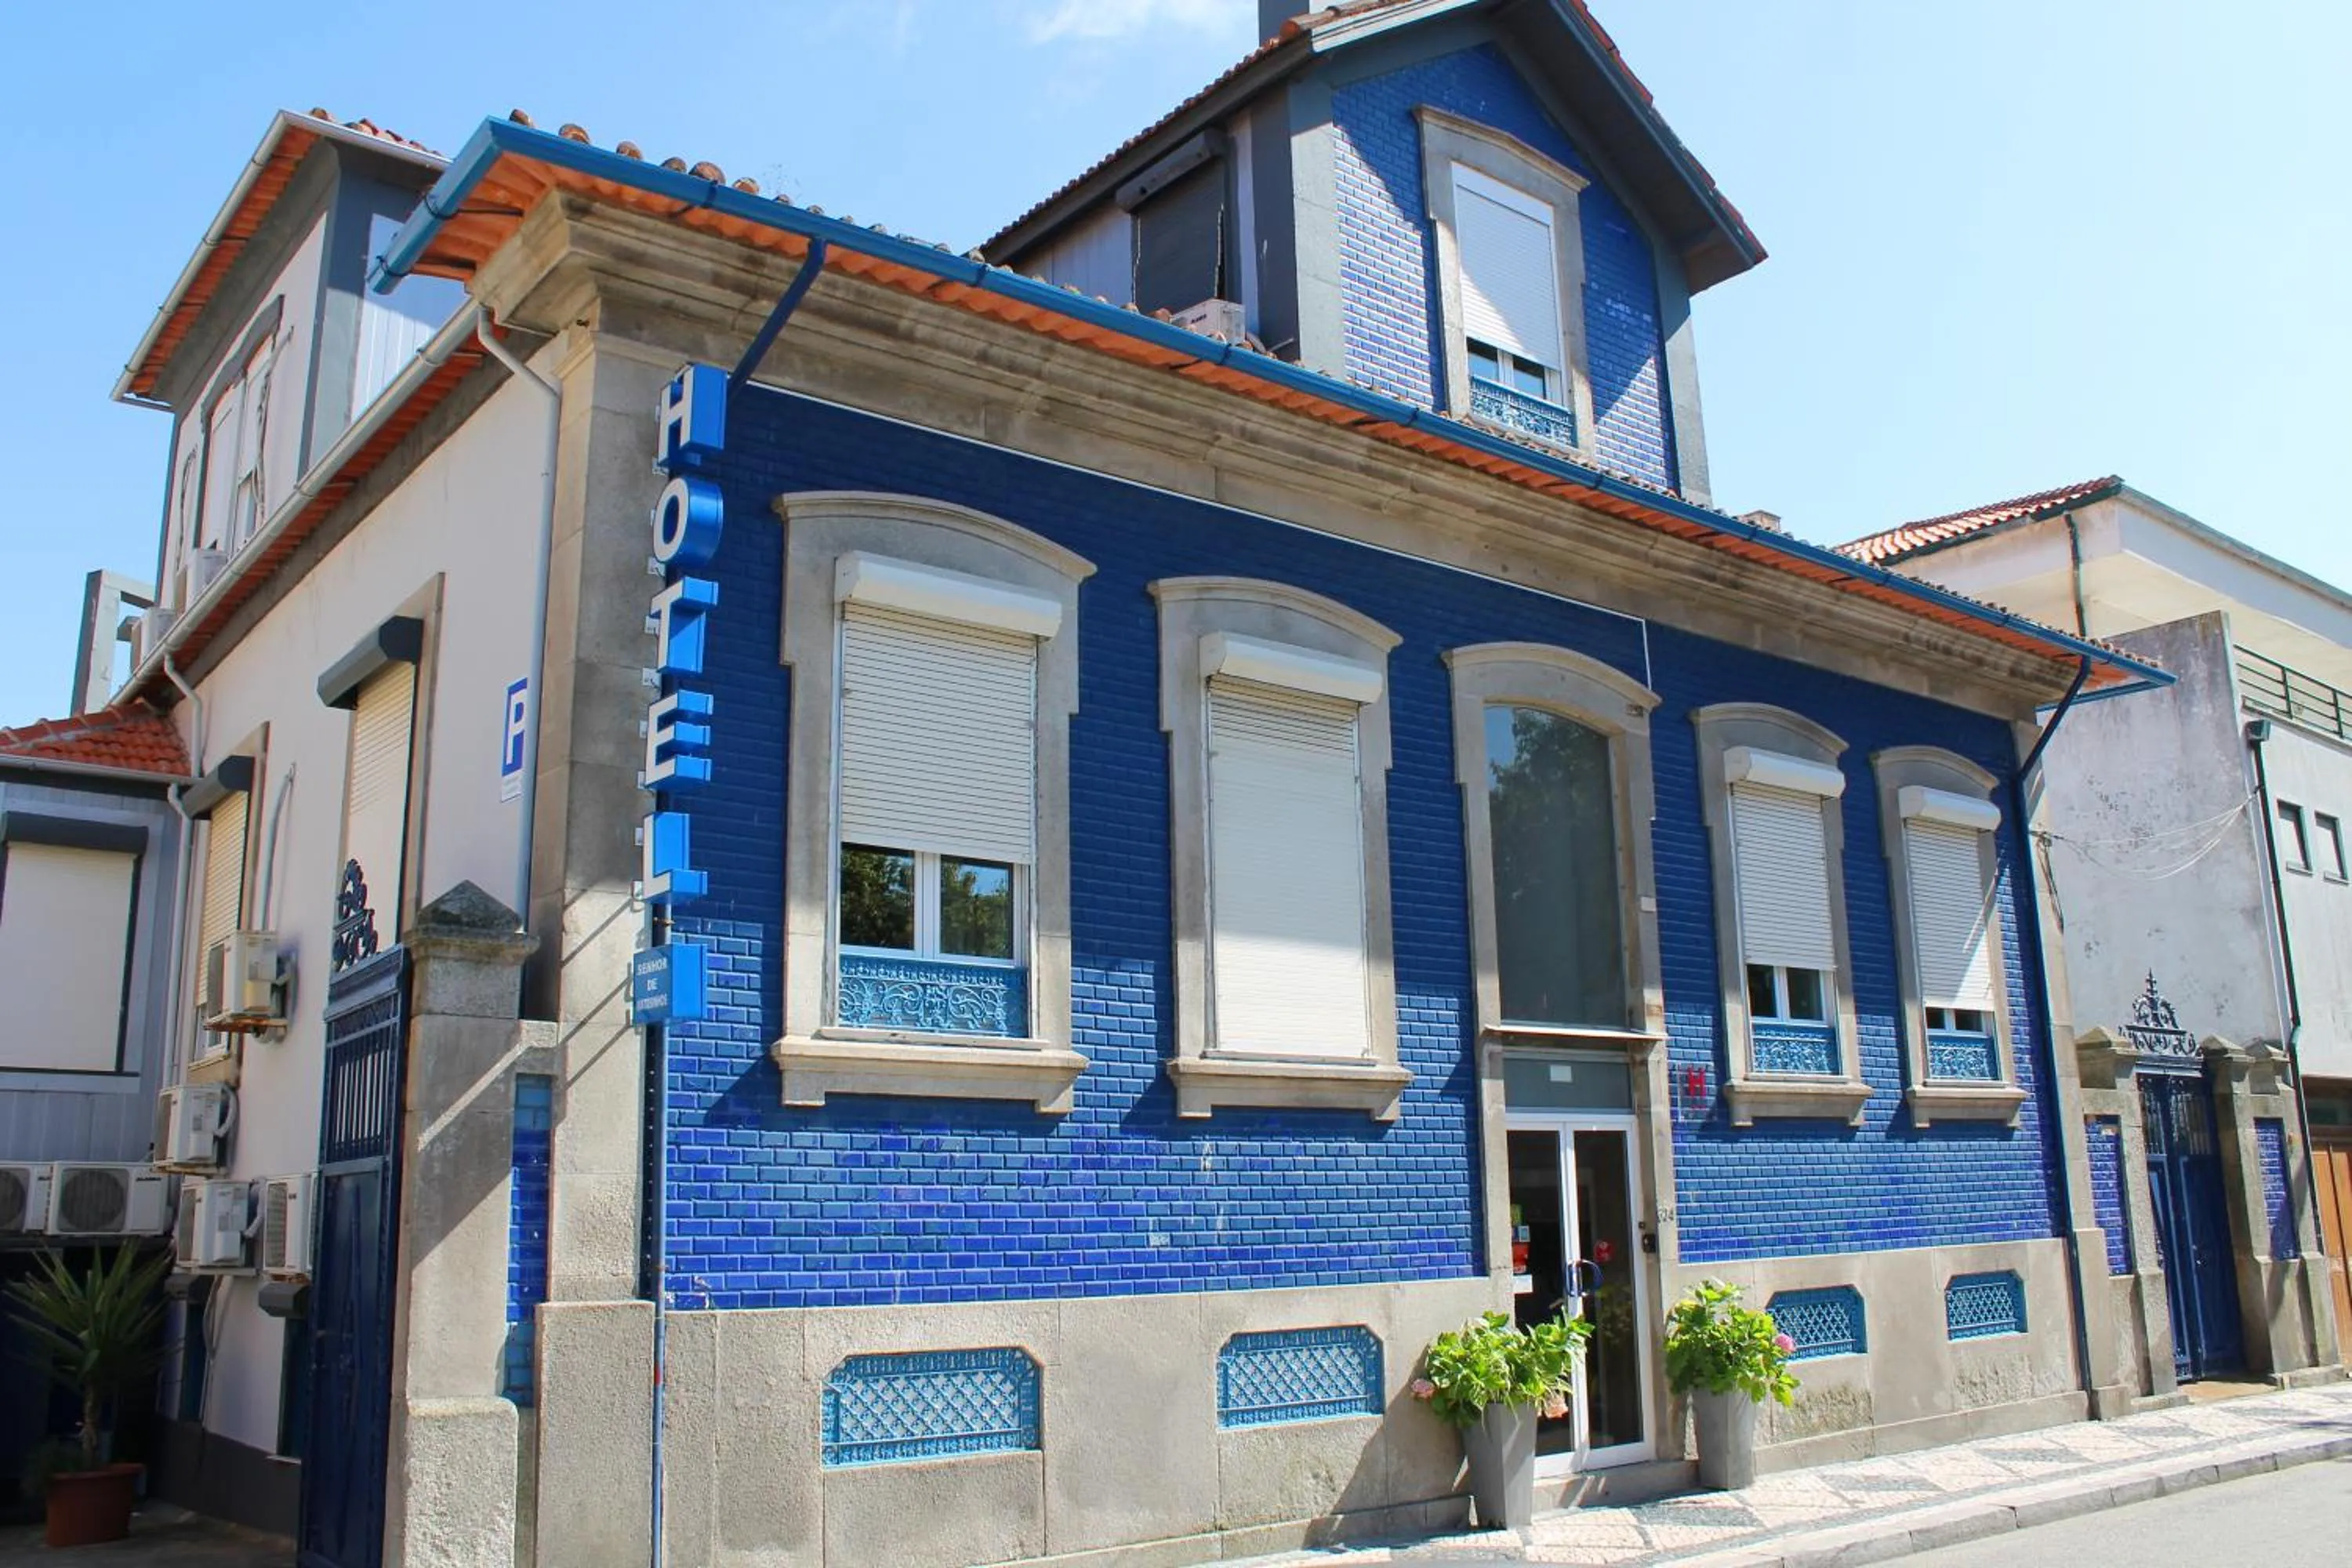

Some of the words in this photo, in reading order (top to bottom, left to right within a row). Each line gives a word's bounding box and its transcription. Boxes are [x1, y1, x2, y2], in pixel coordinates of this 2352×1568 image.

[643, 364, 724, 903] HOTEL
[506, 688, 526, 765] P
[637, 957, 668, 975] SENHOR
[647, 978, 658, 991] DE
